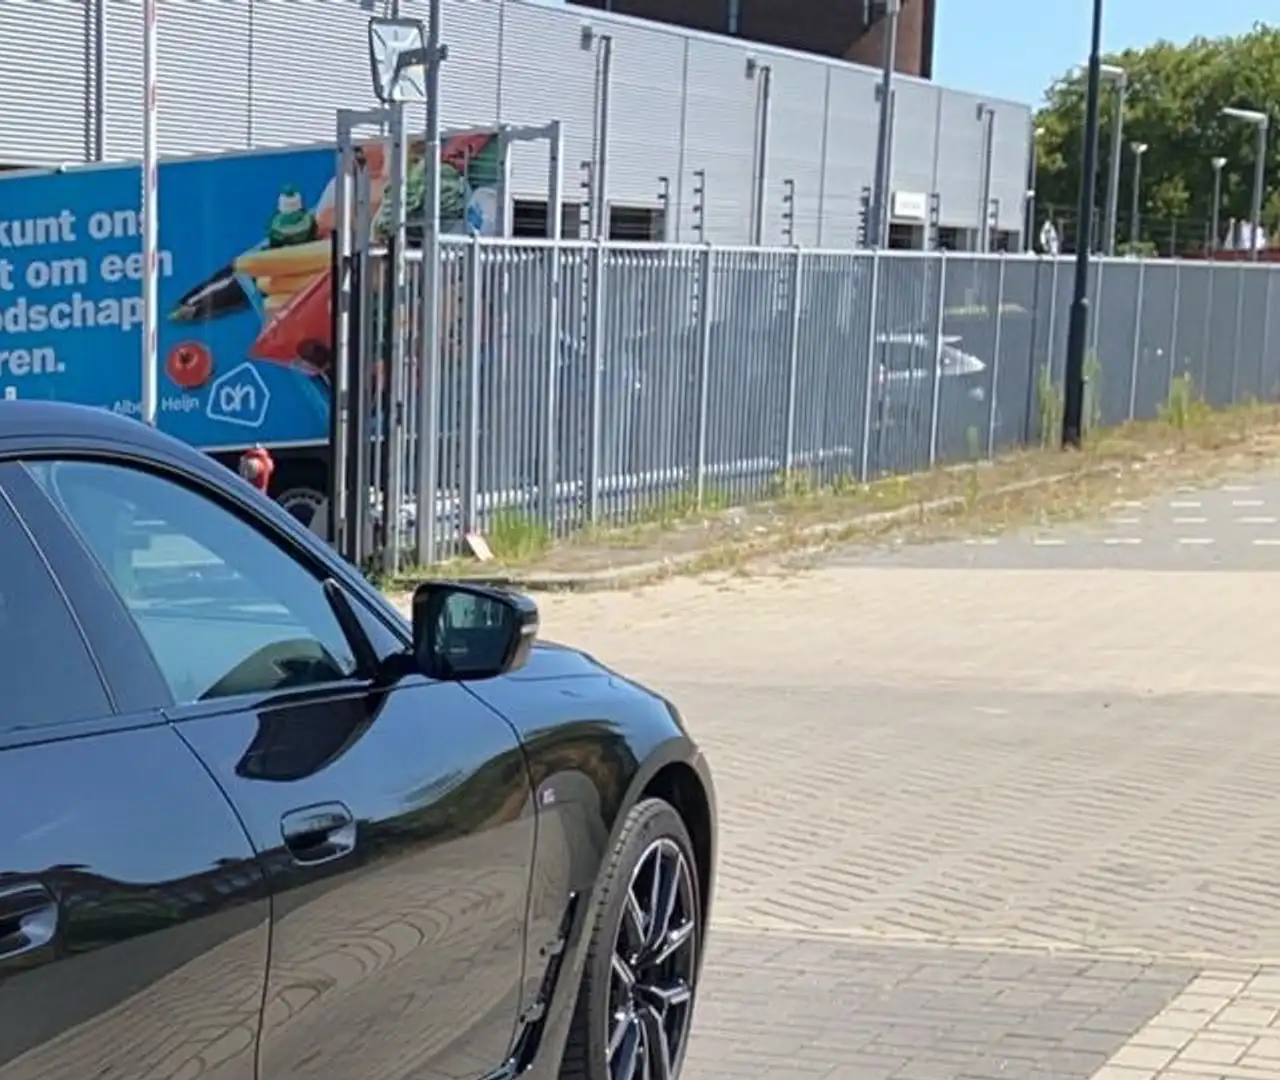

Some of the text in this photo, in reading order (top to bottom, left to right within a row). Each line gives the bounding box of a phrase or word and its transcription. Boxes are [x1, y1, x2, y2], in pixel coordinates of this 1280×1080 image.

[88, 209, 146, 240] on
[26, 257, 88, 288] om
[161, 394, 200, 413] Heijn
